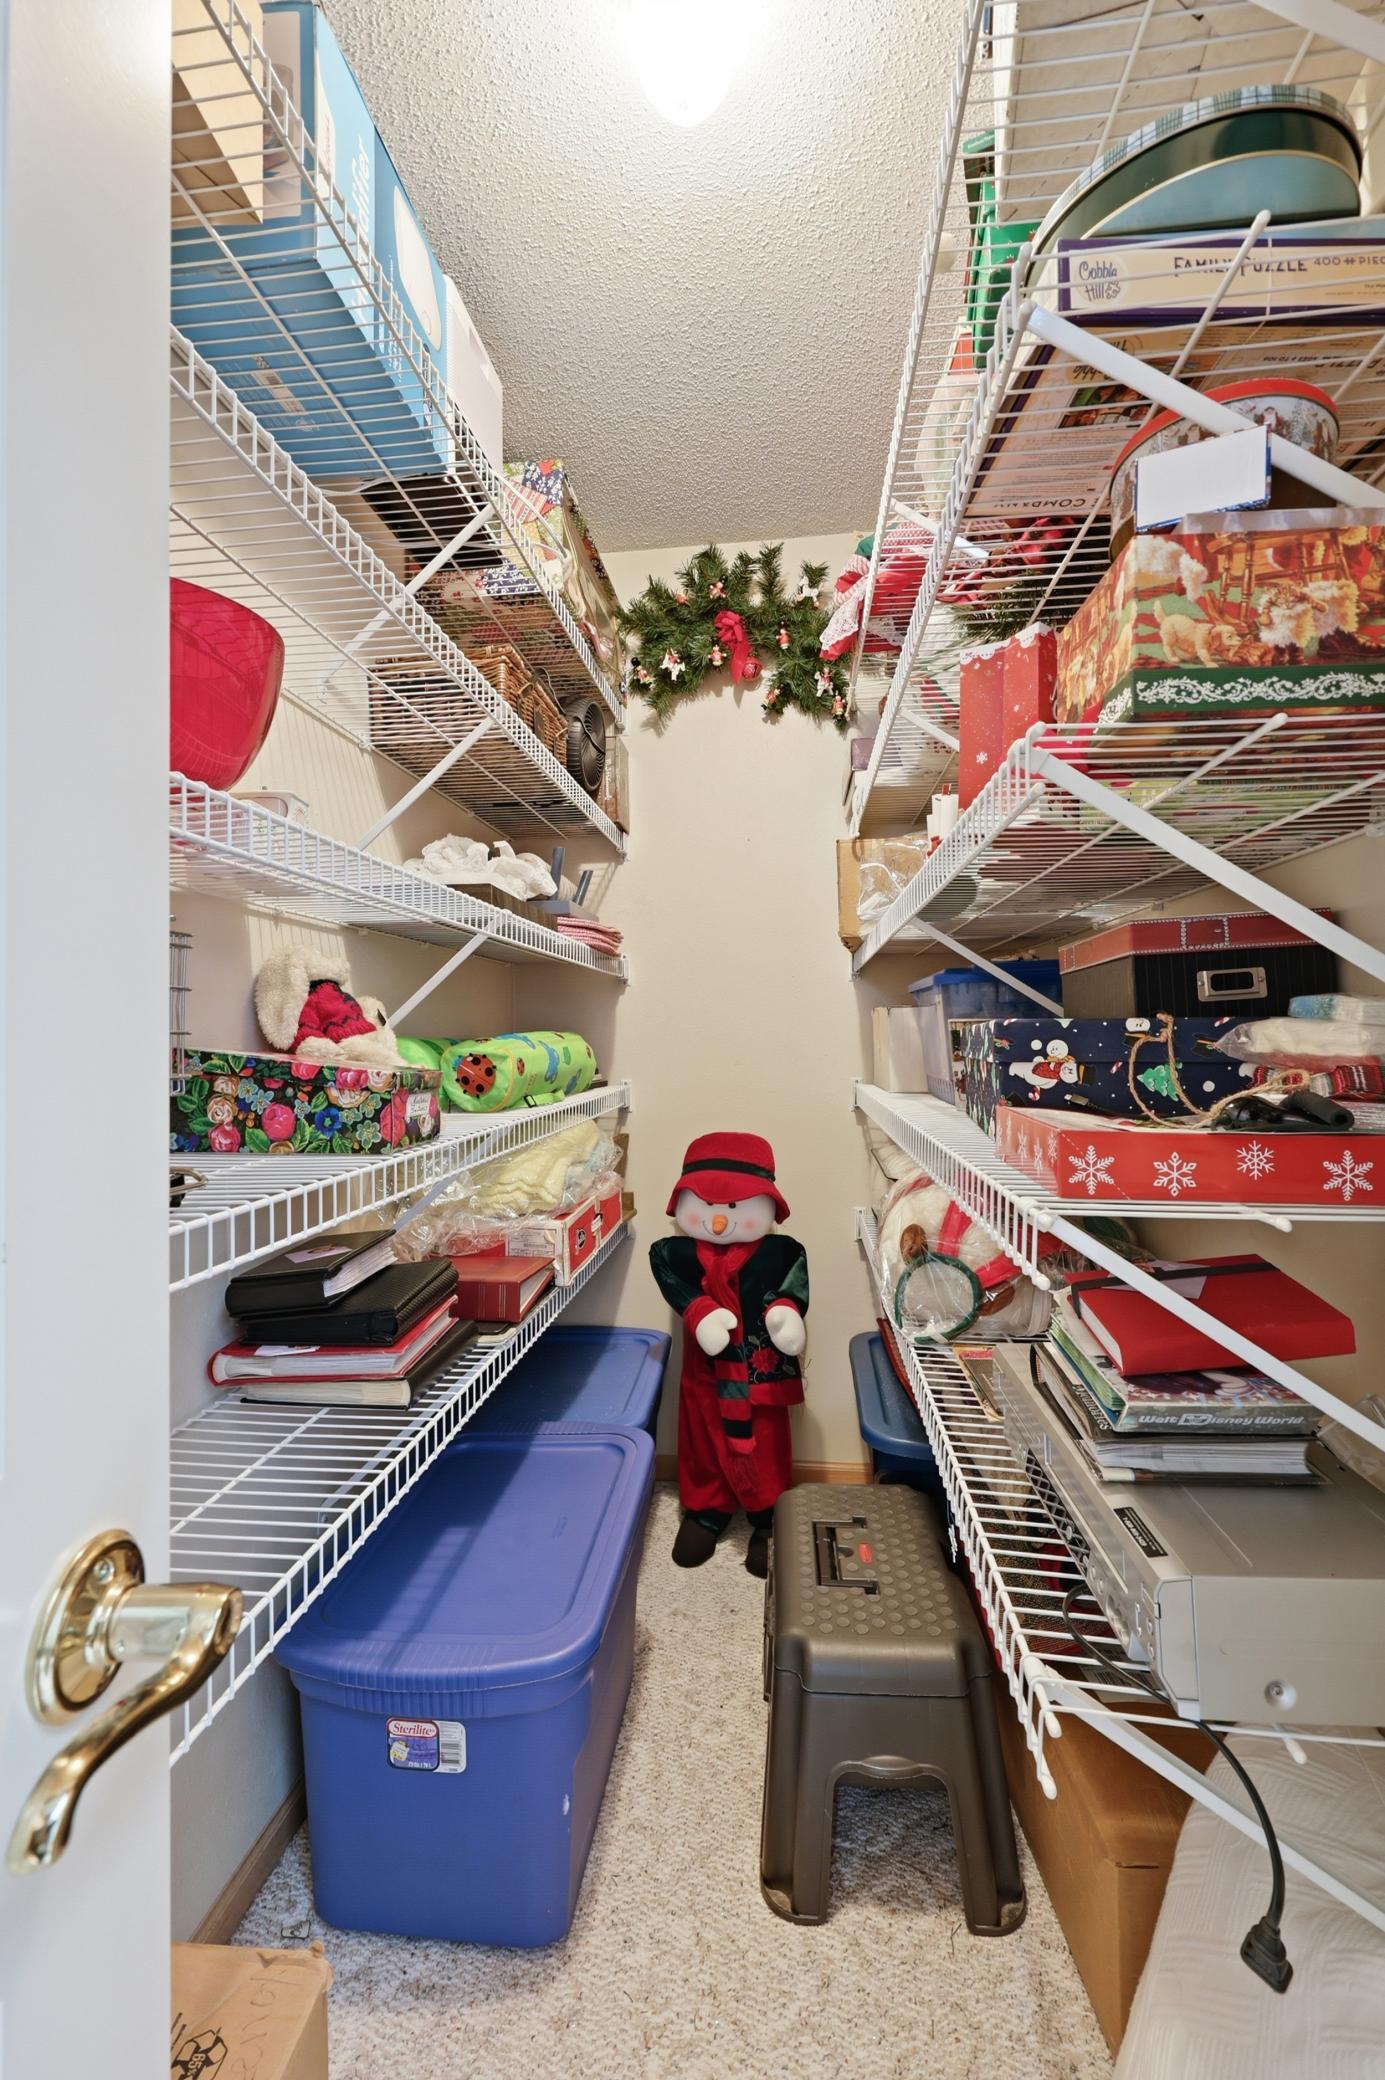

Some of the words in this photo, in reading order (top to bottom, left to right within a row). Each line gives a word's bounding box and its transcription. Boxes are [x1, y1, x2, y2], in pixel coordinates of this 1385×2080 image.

[1174, 257, 1233, 277] FAMILY
[1313, 256, 1341, 266] 400
[1078, 260, 1117, 281] Cobble
[1085, 281, 1105, 302] Hill
[1138, 1414, 1178, 1424] Walt
[1177, 1412, 1253, 1427] Disney
[1253, 1414, 1305, 1425] World
[393, 1722, 432, 1736] Sterilite
